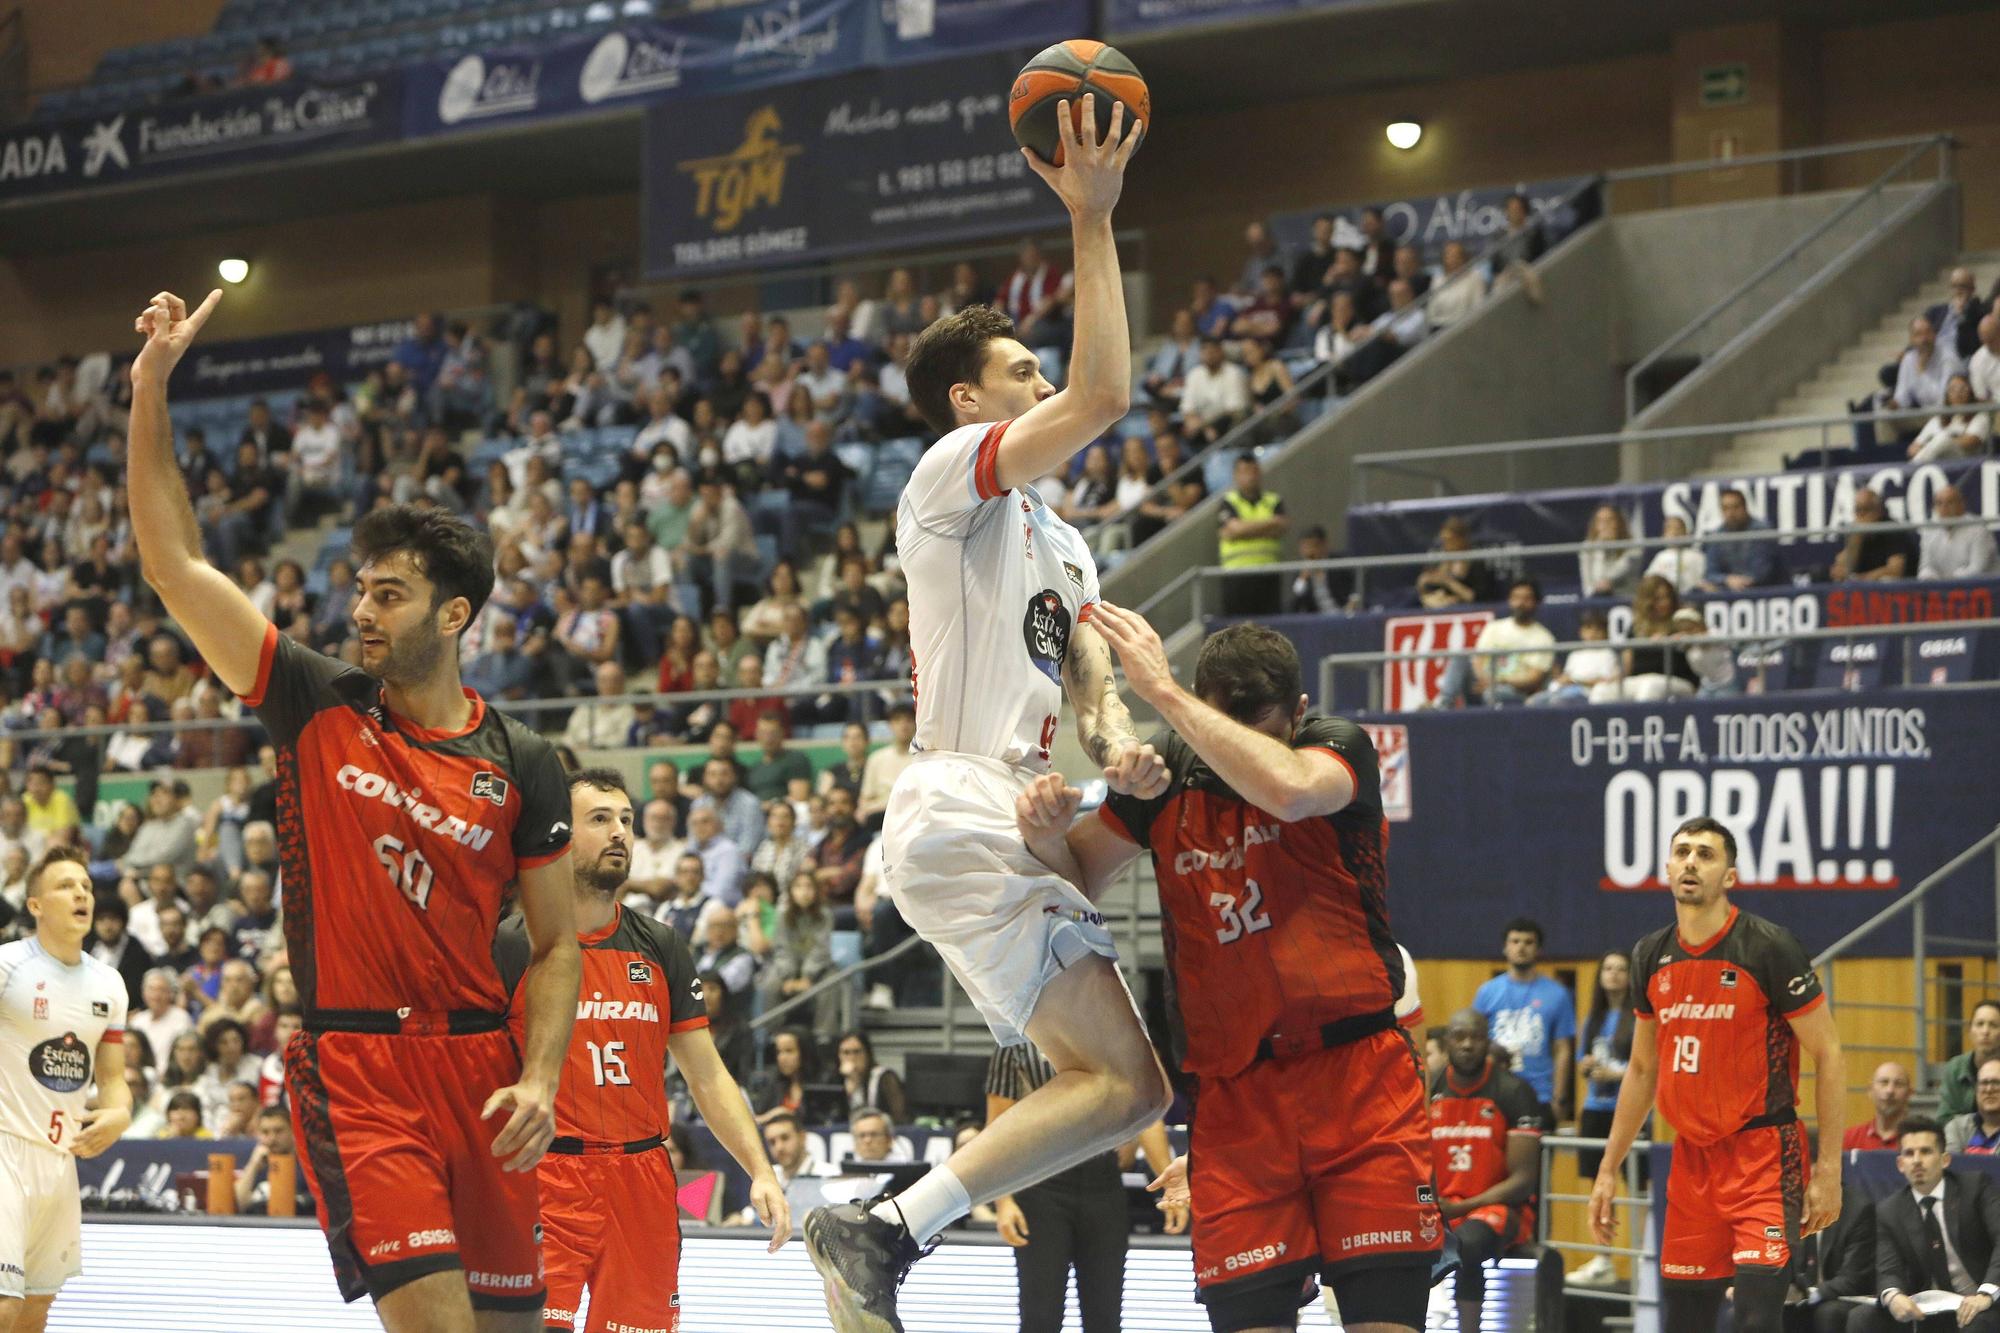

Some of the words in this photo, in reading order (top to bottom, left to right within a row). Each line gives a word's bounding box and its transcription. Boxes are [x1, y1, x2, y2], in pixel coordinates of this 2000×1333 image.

[1607, 593, 1820, 644] ODOIRO
[1826, 587, 1994, 630] SANTIAGO
[1713, 712, 1808, 763] TODOS
[1209, 878, 1272, 945] 32
[586, 1041, 631, 1086] 15
[1672, 1035, 1700, 1073] 19
[48, 1110, 64, 1144] 5
[1353, 1230, 1412, 1248] BERNER
[469, 1270, 534, 1288] BERNER
